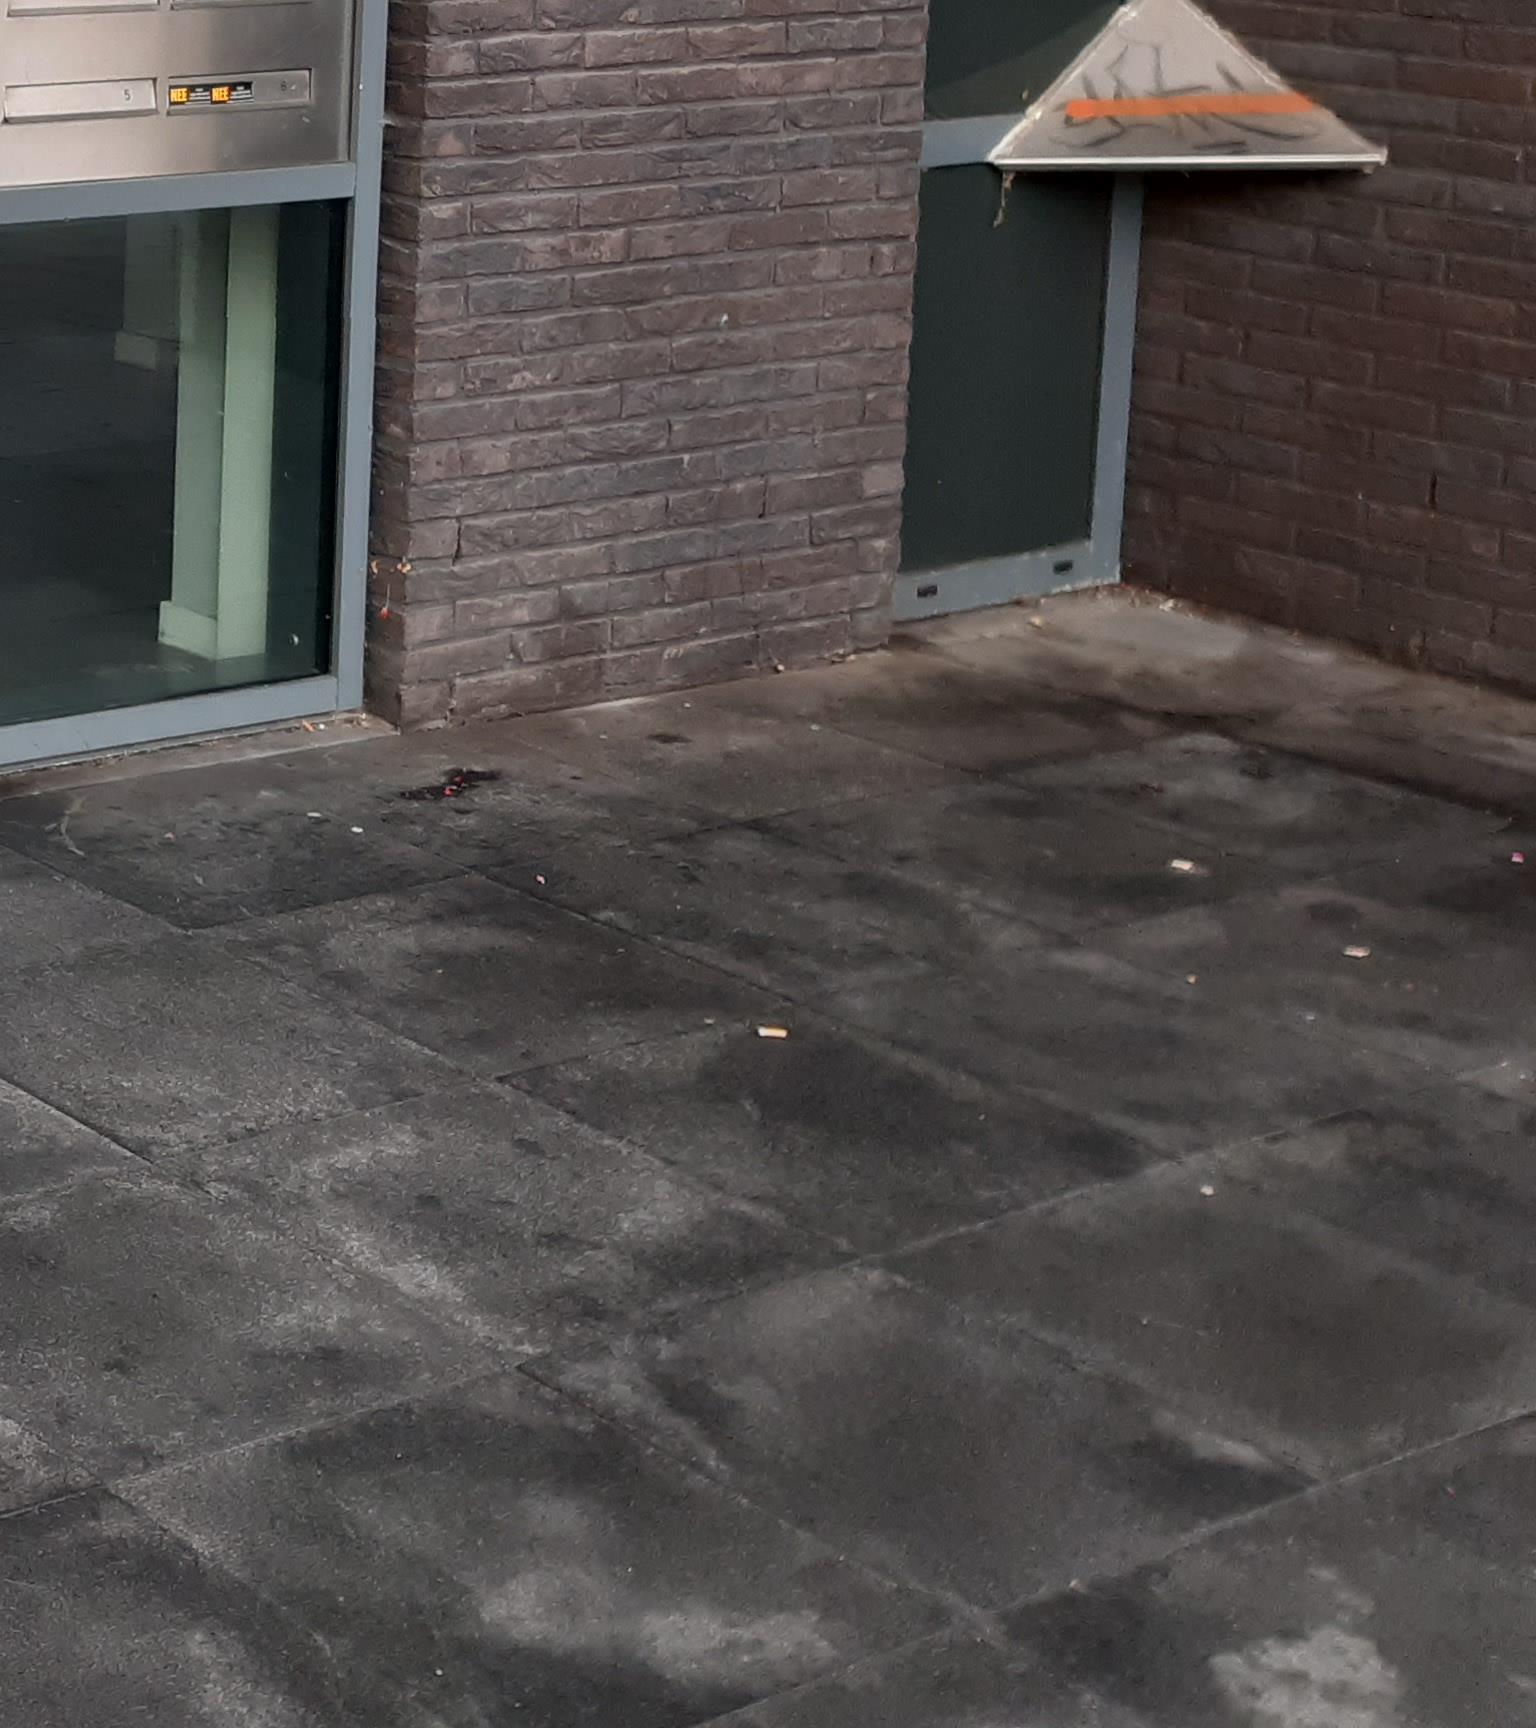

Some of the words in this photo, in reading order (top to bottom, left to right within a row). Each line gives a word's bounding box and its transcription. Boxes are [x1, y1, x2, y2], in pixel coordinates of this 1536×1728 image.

[123, 89, 132, 102] 5
[170, 87, 188, 103] NEE
[211, 85, 231, 102] NEE
